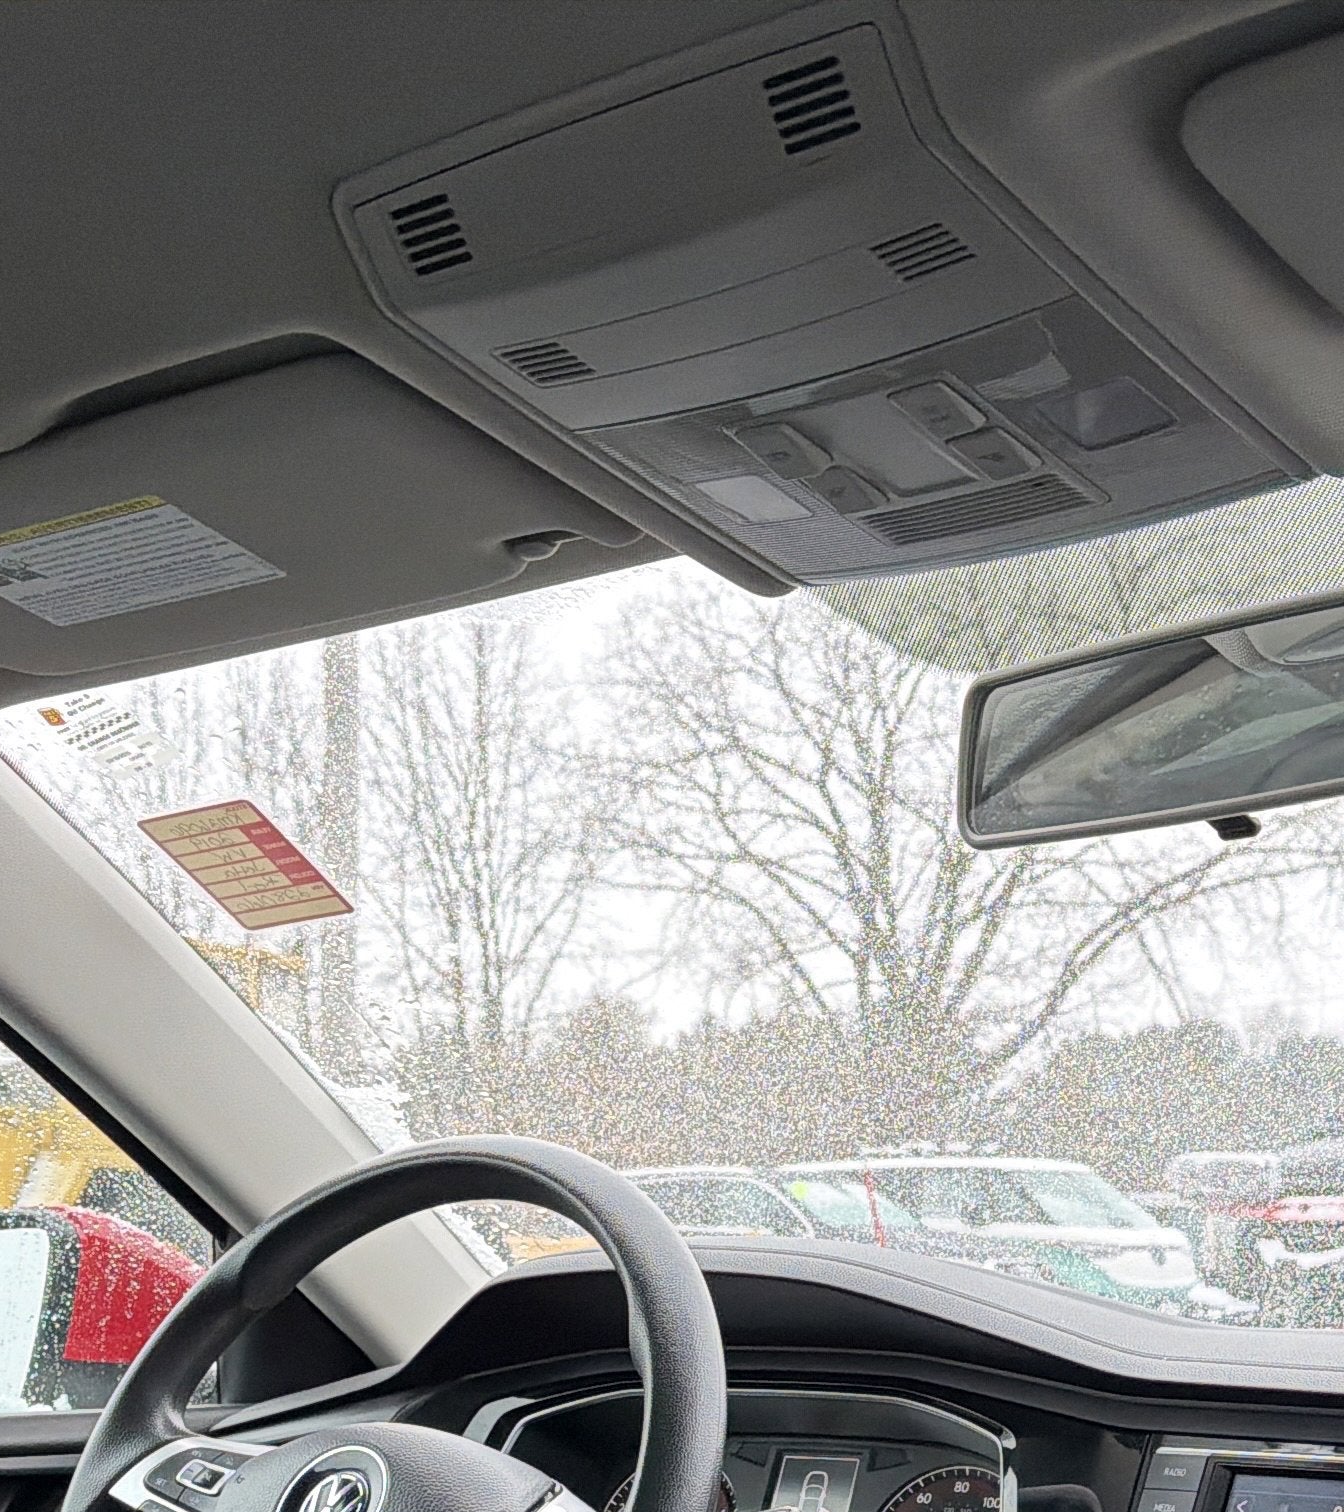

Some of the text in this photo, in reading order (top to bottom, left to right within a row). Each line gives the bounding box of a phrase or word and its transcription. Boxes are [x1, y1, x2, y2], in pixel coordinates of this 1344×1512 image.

[1163, 1466, 1187, 1477] RADIO
[953, 1481, 971, 1493] 80
[916, 1492, 933, 1505] 60
[981, 1496, 1001, 1509] 100
